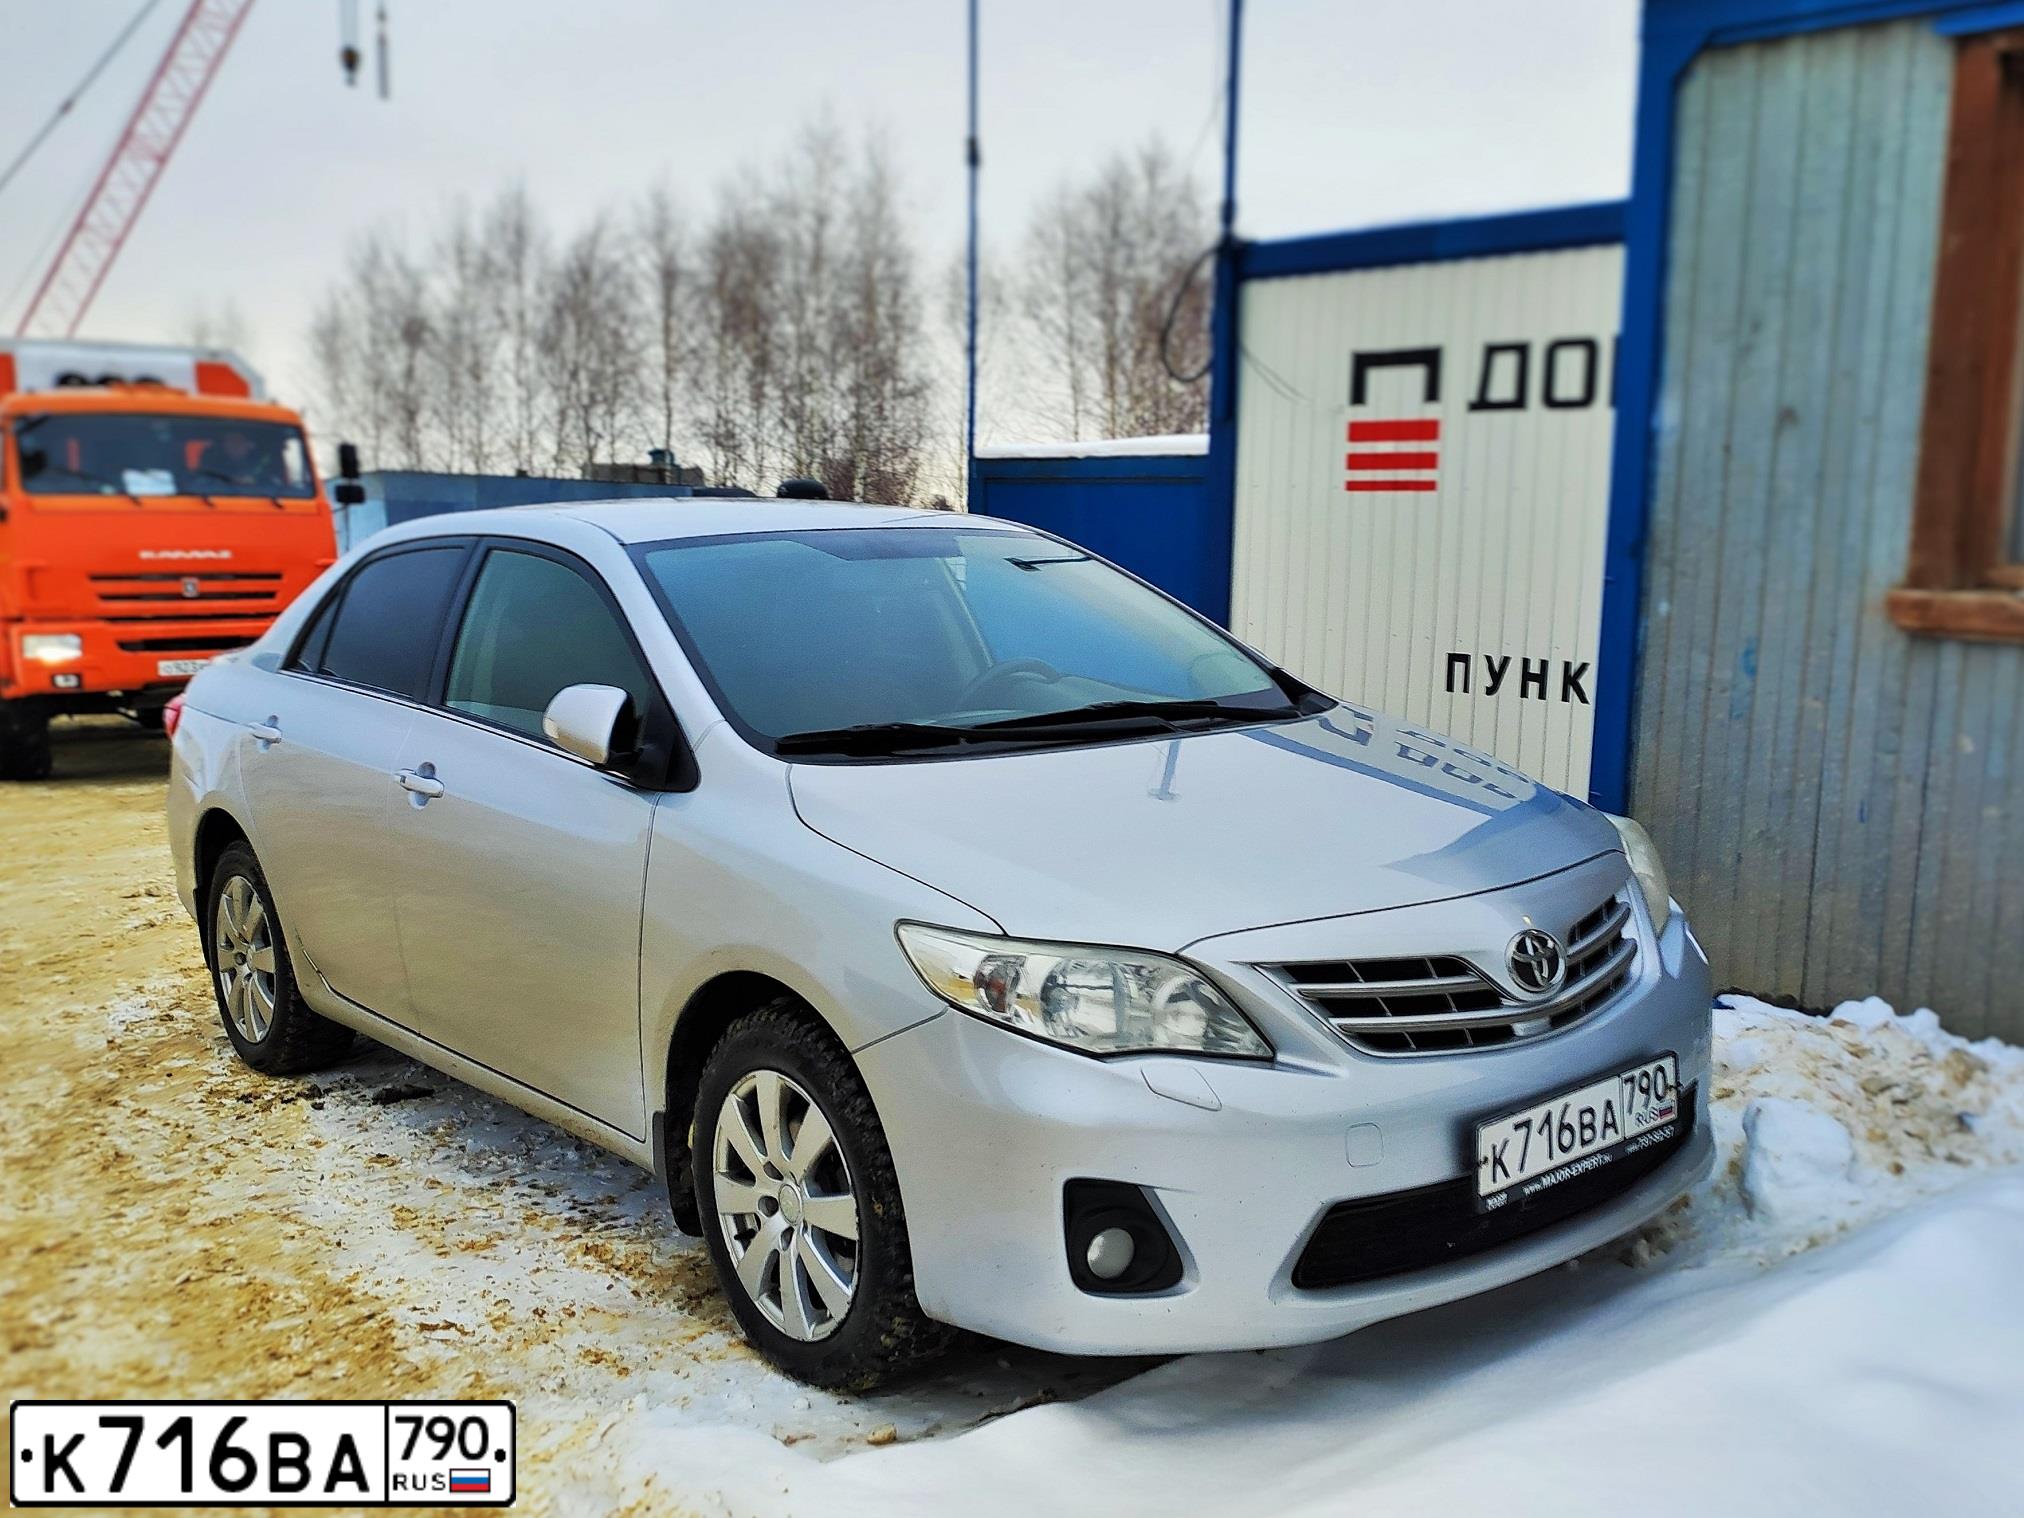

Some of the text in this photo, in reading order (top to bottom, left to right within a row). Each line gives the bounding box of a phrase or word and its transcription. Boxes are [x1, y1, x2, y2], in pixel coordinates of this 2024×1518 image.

[1468, 337, 1620, 412] ДО
[1446, 652, 1591, 704] ПУНК
[1491, 1099, 1620, 1183] К716ВА
[1623, 1064, 1668, 1115] 790
